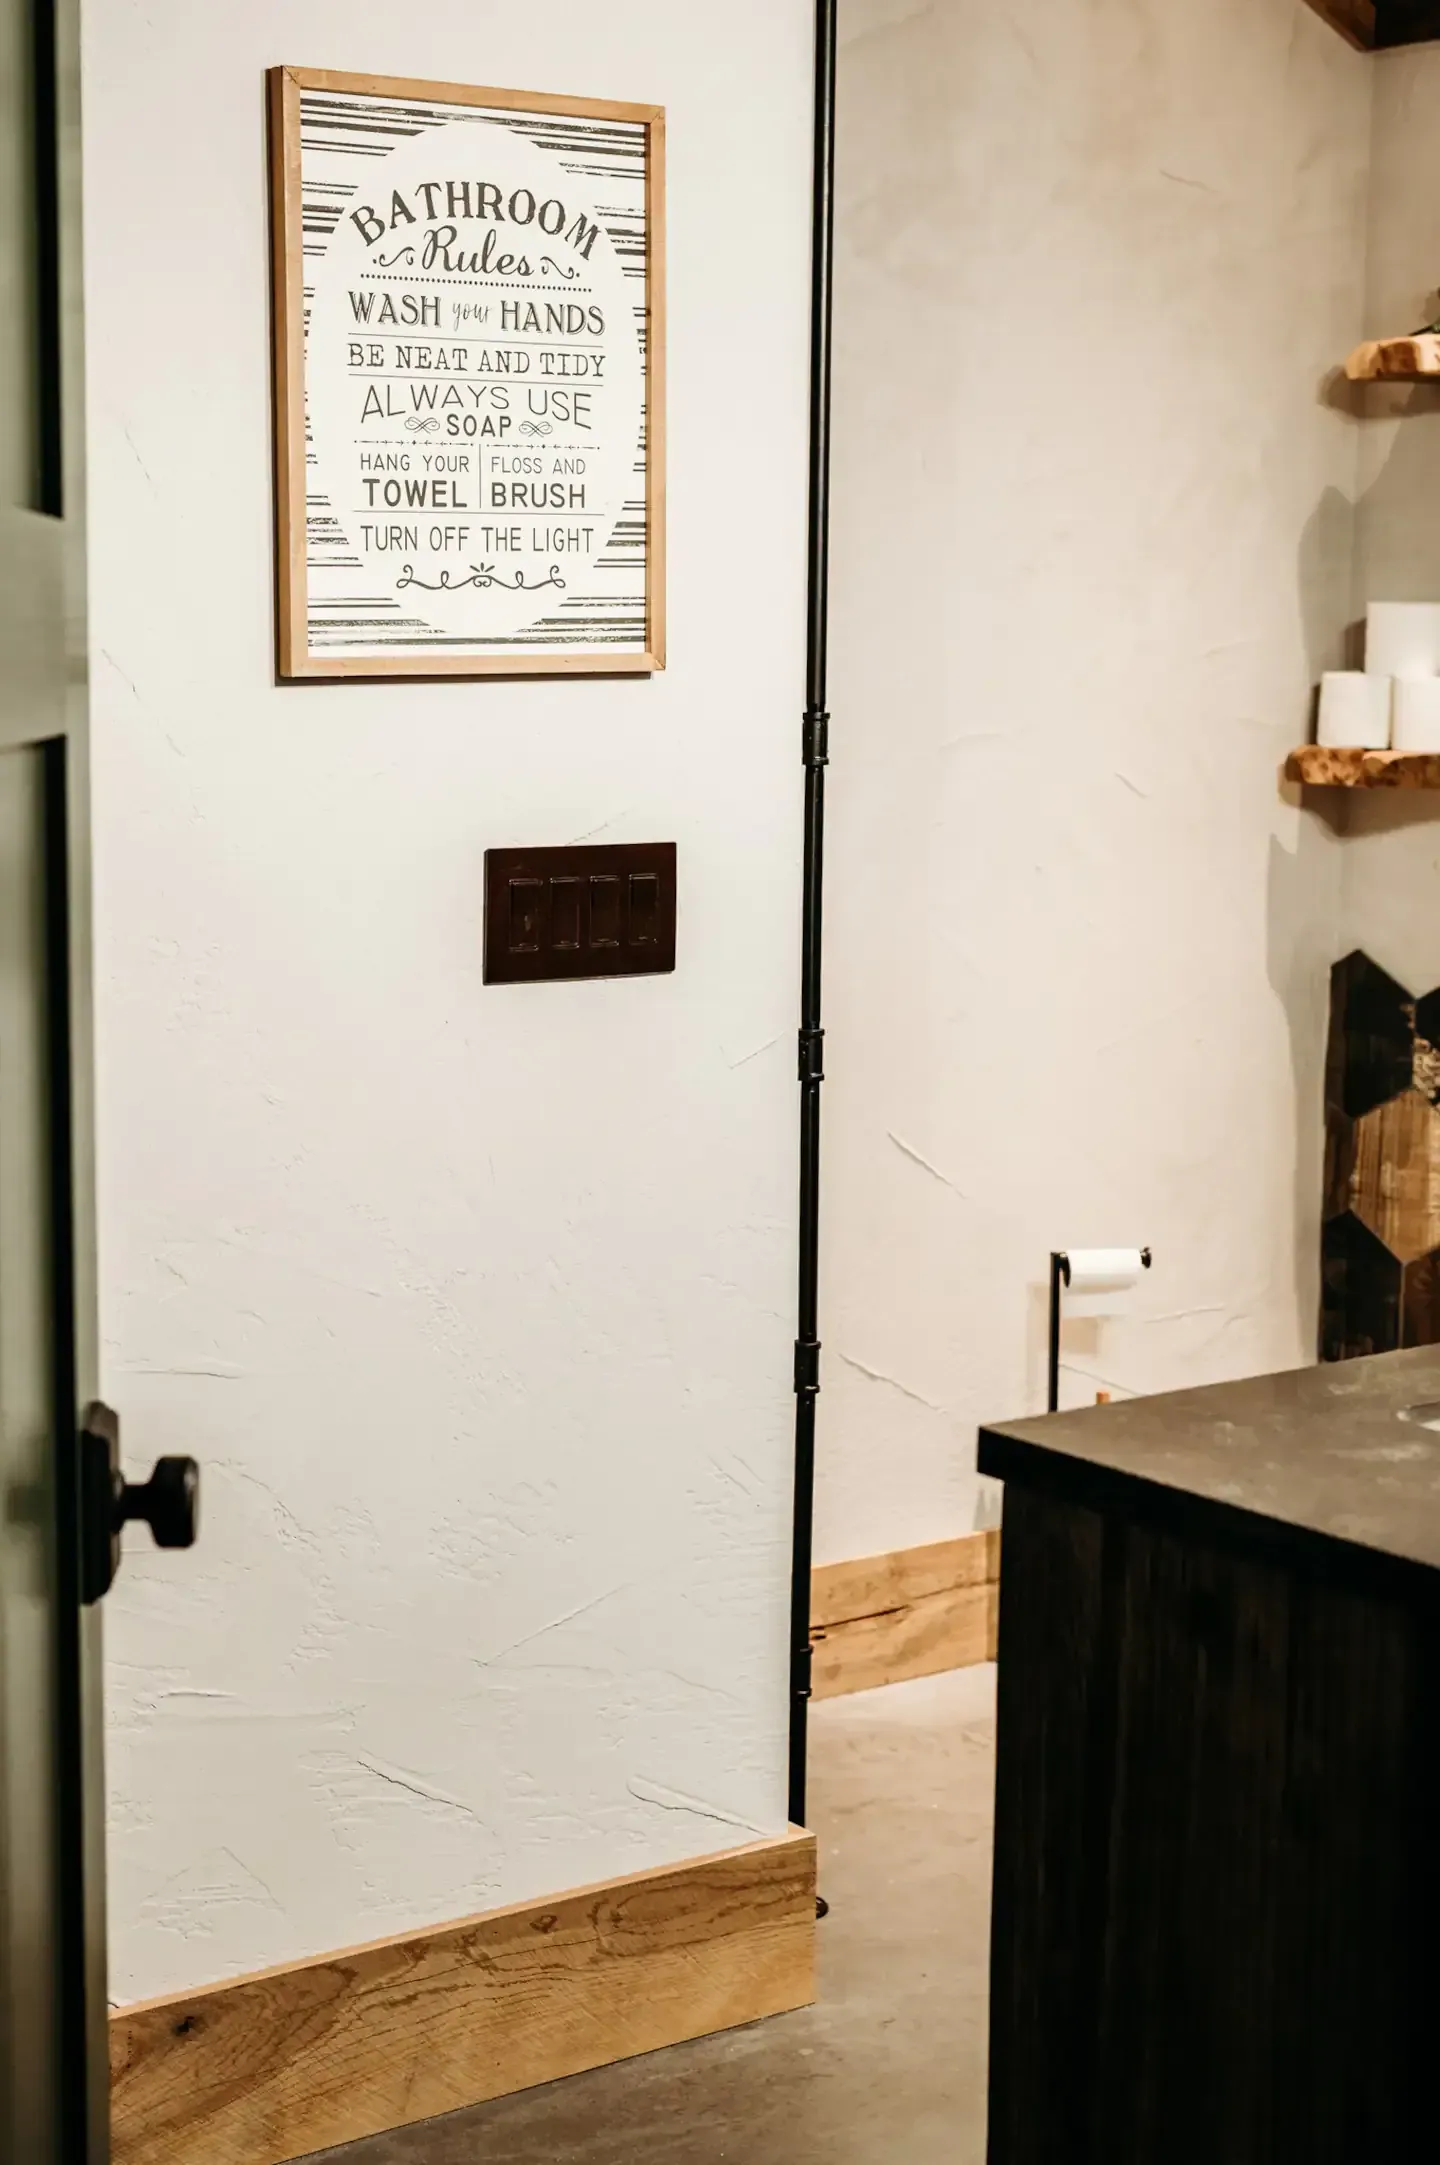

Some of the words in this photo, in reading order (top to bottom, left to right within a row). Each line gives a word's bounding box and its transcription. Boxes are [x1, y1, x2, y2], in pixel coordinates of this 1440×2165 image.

[349, 180, 602, 260] BATHROOM
[422, 225, 534, 276] Rules
[348, 290, 442, 328] WASH
[452, 302, 492, 332] your
[500, 300, 606, 336] HANDS
[346, 343, 384, 367] BE
[395, 345, 468, 371] NEAT
[477, 350, 530, 374] AND
[540, 353, 606, 377] TIDY
[360, 384, 510, 424] ALWAYS
[528, 388, 592, 430] USE
[446, 414, 512, 437] SOAP
[360, 453, 410, 471] HANG
[422, 455, 470, 472] YOUR
[491, 456, 542, 474] FLOSS
[552, 458, 586, 474] AND
[362, 478, 468, 508] TOWEL
[491, 482, 586, 508] BRUSH
[360, 525, 418, 552] TURN
[430, 526, 470, 552] OFF
[481, 527, 522, 552] THE
[533, 528, 594, 553] LIGHT
